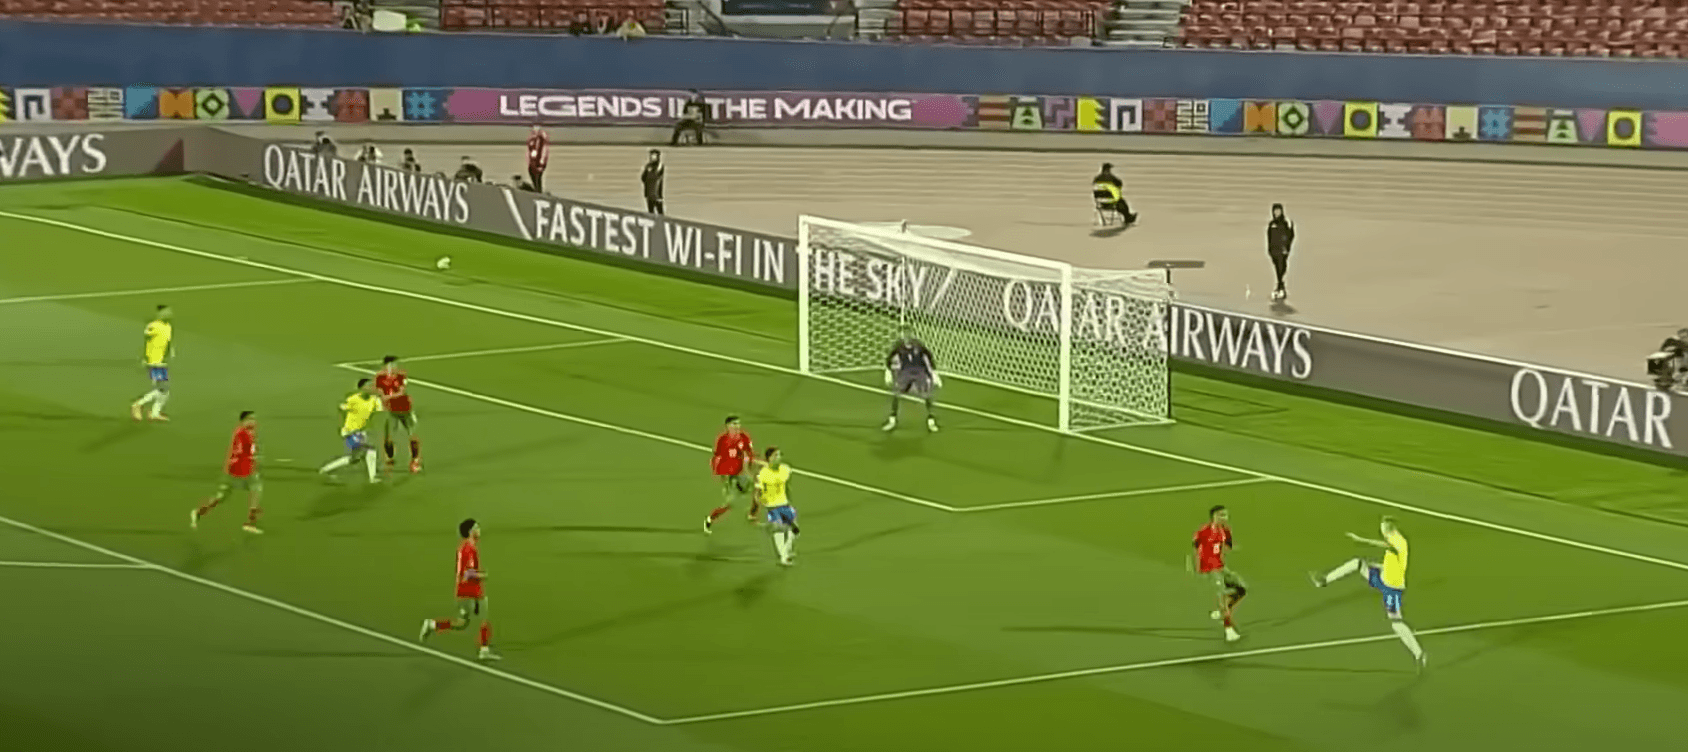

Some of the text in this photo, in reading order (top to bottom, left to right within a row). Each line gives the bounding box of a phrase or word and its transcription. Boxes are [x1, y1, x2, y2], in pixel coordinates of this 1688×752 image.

[500, 95, 662, 118] LEGENDS
[704, 97, 767, 119] THE
[774, 97, 912, 120] MAKING
[265, 144, 470, 224] QATAR AIRWAYS
[534, 199, 655, 259] FASTEST
[664, 221, 742, 276] WI-FI
[753, 237, 785, 284] IN
[796, 246, 857, 296] HE
[1003, 279, 1314, 380] QAAR AIRWAYS
[1510, 367, 1674, 449] QATAR
